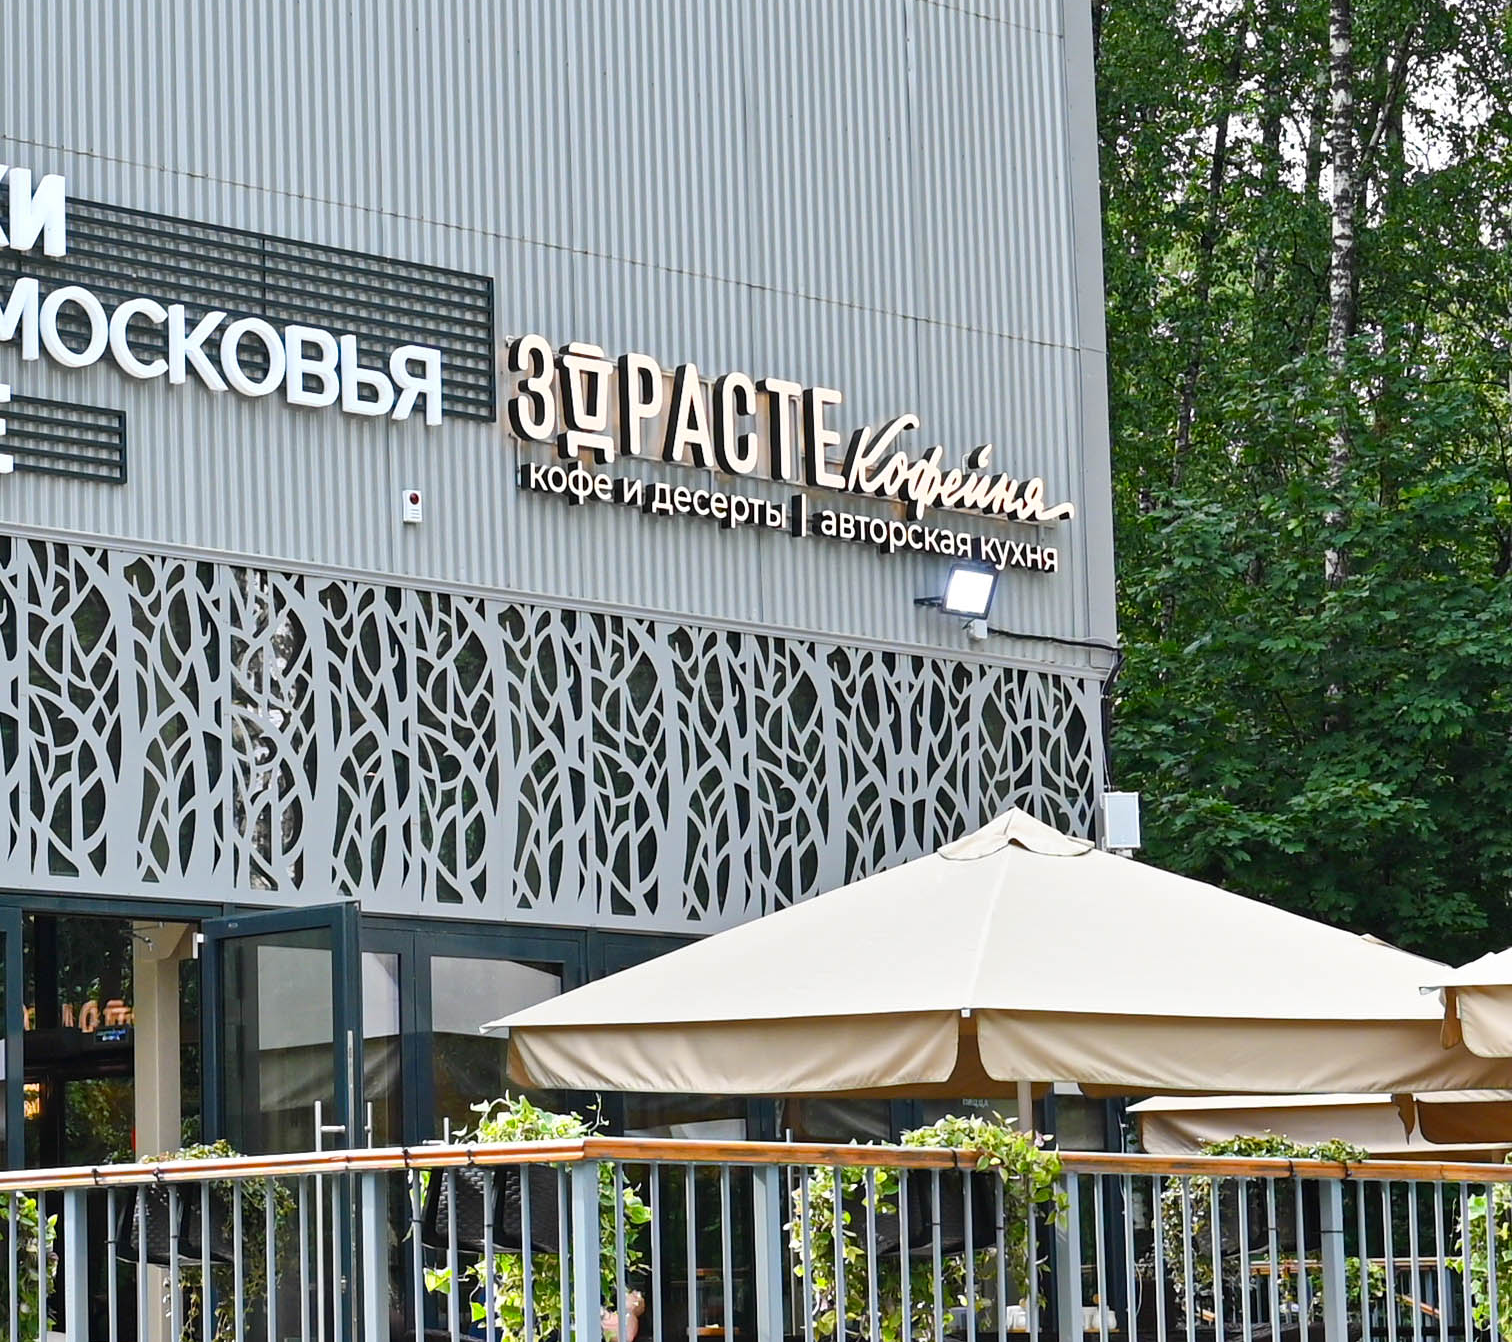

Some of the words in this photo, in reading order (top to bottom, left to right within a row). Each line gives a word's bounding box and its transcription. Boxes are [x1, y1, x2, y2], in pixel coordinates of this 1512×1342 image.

[529, 461, 613, 505] кофе
[621, 476, 644, 506] и
[651, 481, 787, 530] десерты
[820, 508, 973, 559] авторская
[980, 535, 1059, 573] кухня
[846, 413, 1075, 521] Кофейня
